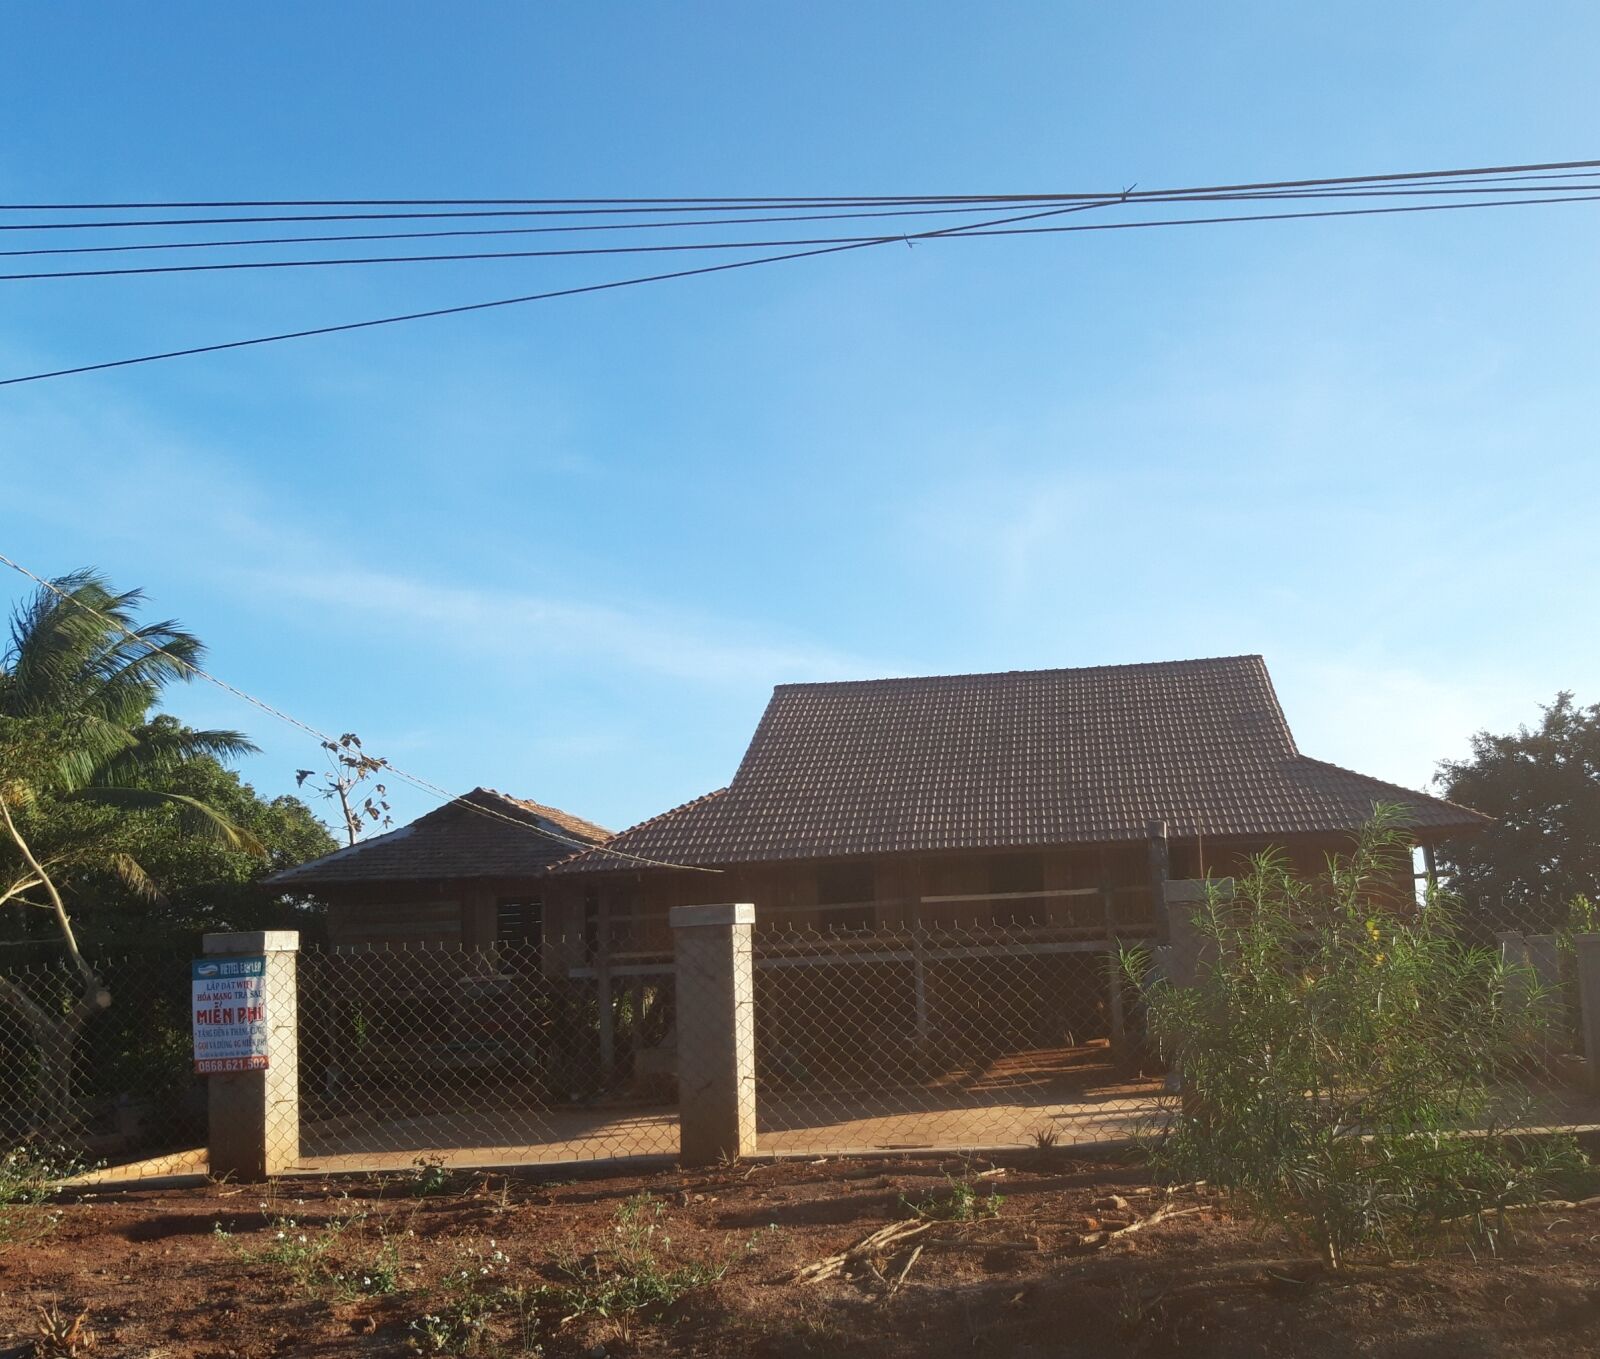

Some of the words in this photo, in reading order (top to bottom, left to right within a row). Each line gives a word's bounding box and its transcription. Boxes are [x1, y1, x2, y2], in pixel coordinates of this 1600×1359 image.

[237, 980, 253, 989] WIFI
[250, 990, 263, 999] SAU
[196, 1001, 234, 1025] MIỄN
[237, 1002, 265, 1024] PHÍ
